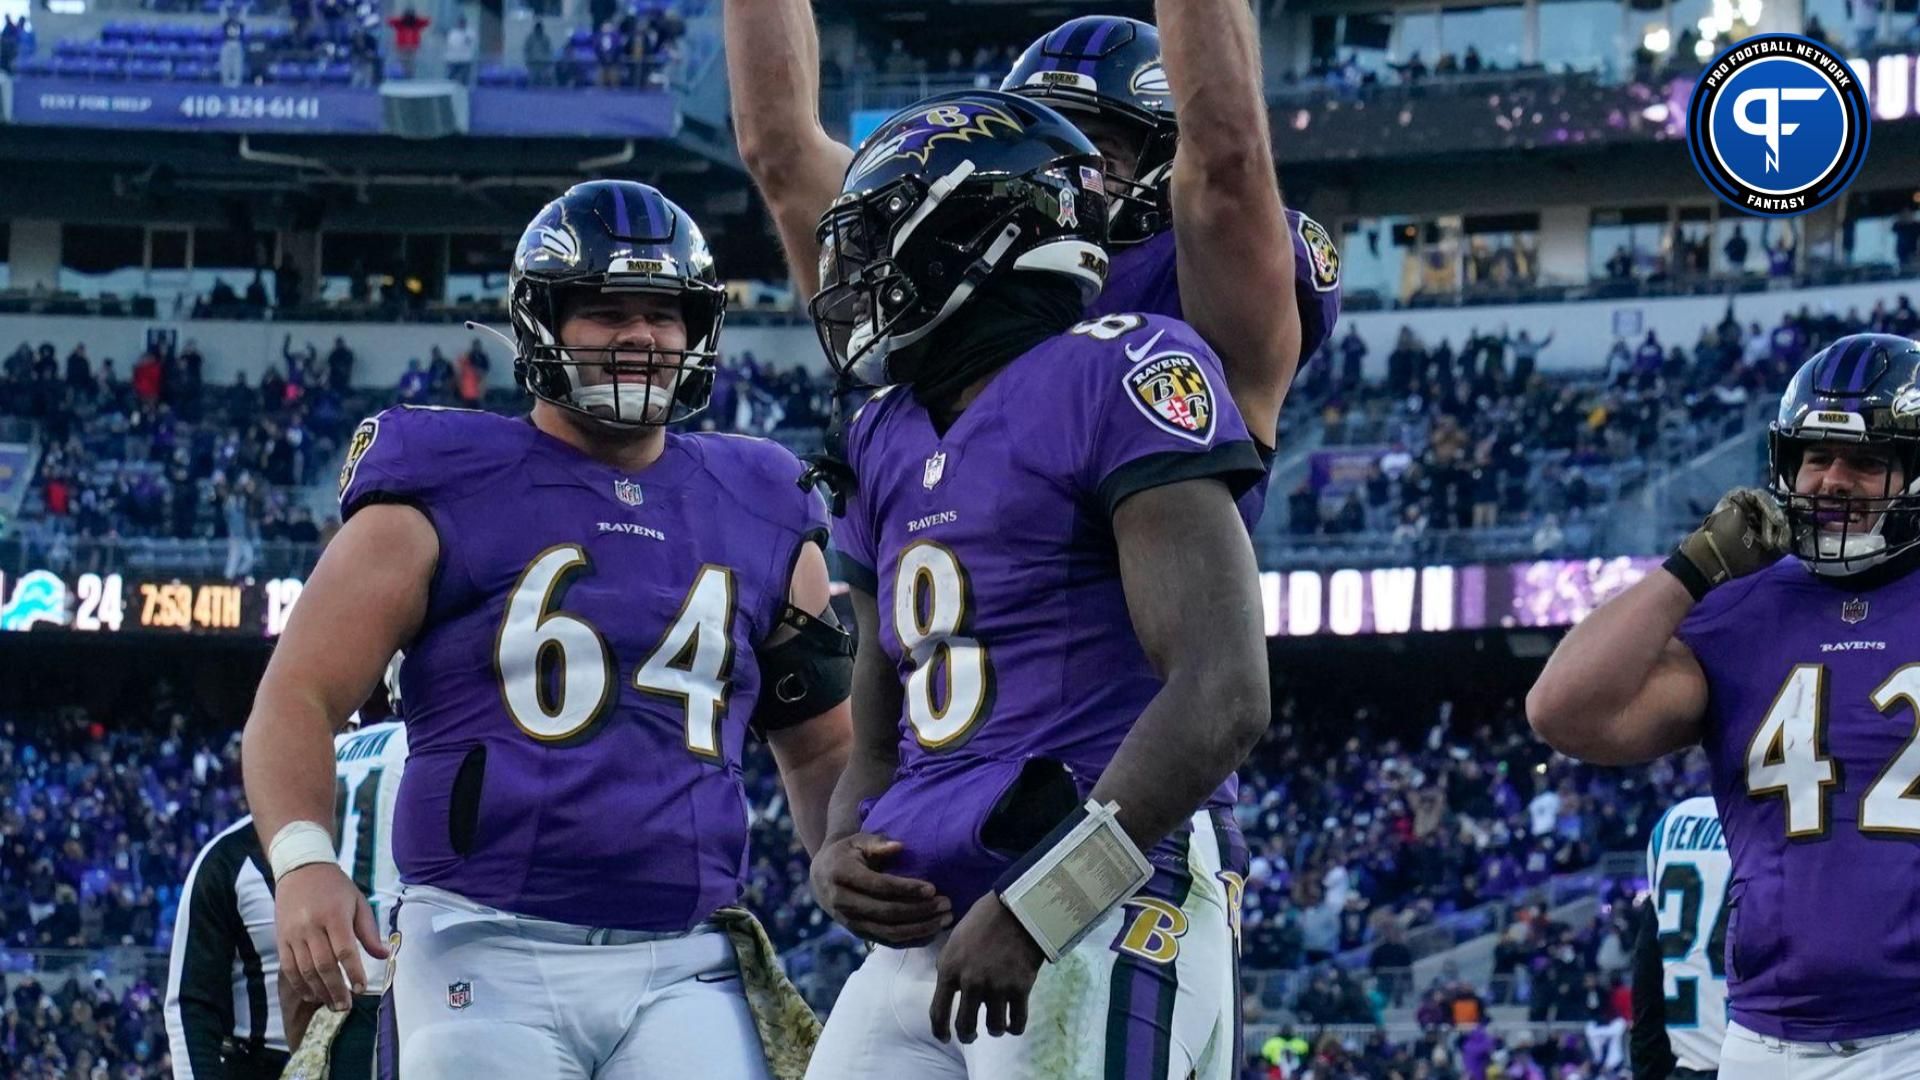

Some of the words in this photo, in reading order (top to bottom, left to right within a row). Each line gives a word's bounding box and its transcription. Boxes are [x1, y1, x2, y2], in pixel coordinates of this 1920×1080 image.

[1042, 73, 1078, 84] RAVENS
[626, 261, 663, 271] RAVENS
[1133, 357, 1191, 384] RAVENS
[1818, 413, 1850, 423] RAVENS
[596, 522, 665, 541] RAVENS
[907, 510, 958, 532] RAVENS
[75, 573, 124, 631] 24
[193, 584, 241, 627] 4TH
[493, 543, 738, 762] 64
[893, 538, 988, 750] 8
[1820, 641, 1886, 652] RAVENS
[1743, 661, 1920, 840] 42
[1666, 815, 1728, 850] HENDE
[1118, 896, 1188, 962] B
